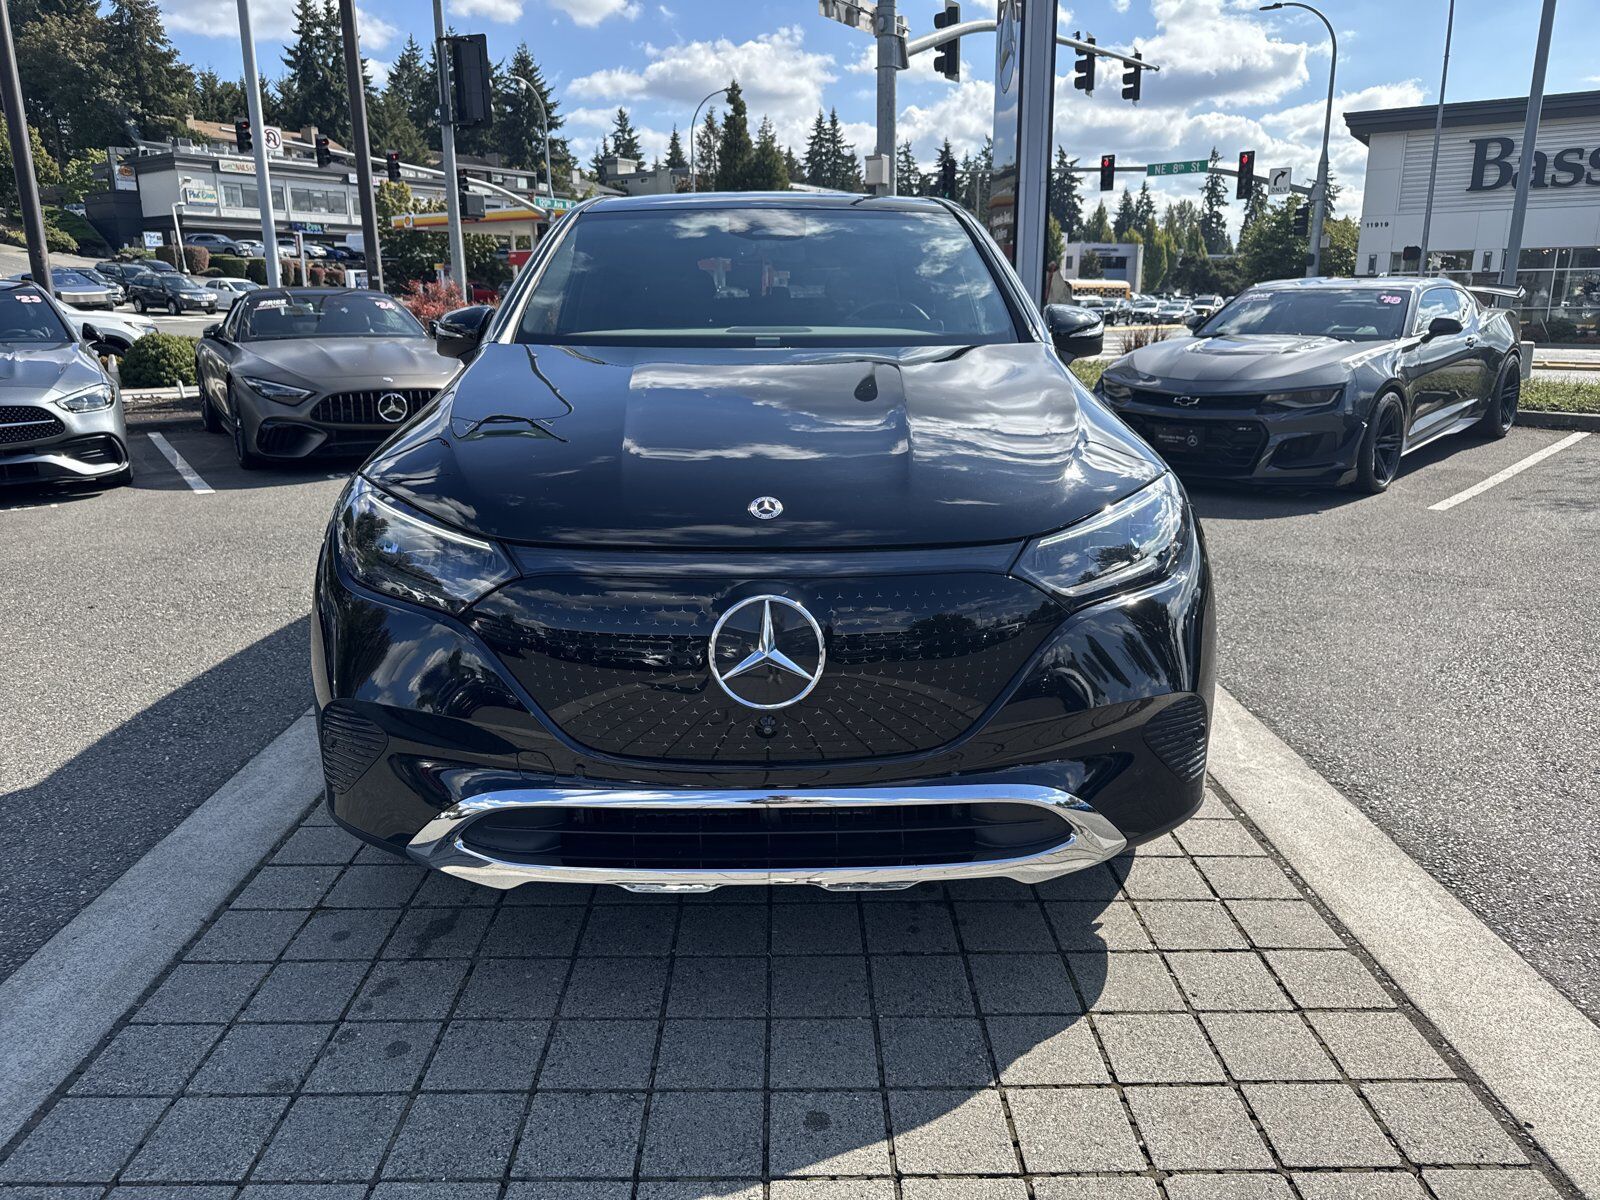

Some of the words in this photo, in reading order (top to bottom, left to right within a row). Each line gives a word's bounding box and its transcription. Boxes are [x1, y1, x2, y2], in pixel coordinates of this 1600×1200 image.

[1154, 165, 1167, 175] NE
[1172, 163, 1185, 173] 8th
[1191, 162, 1201, 172] St
[539, 198, 552, 207] 120th
[554, 199, 563, 208] Ave
